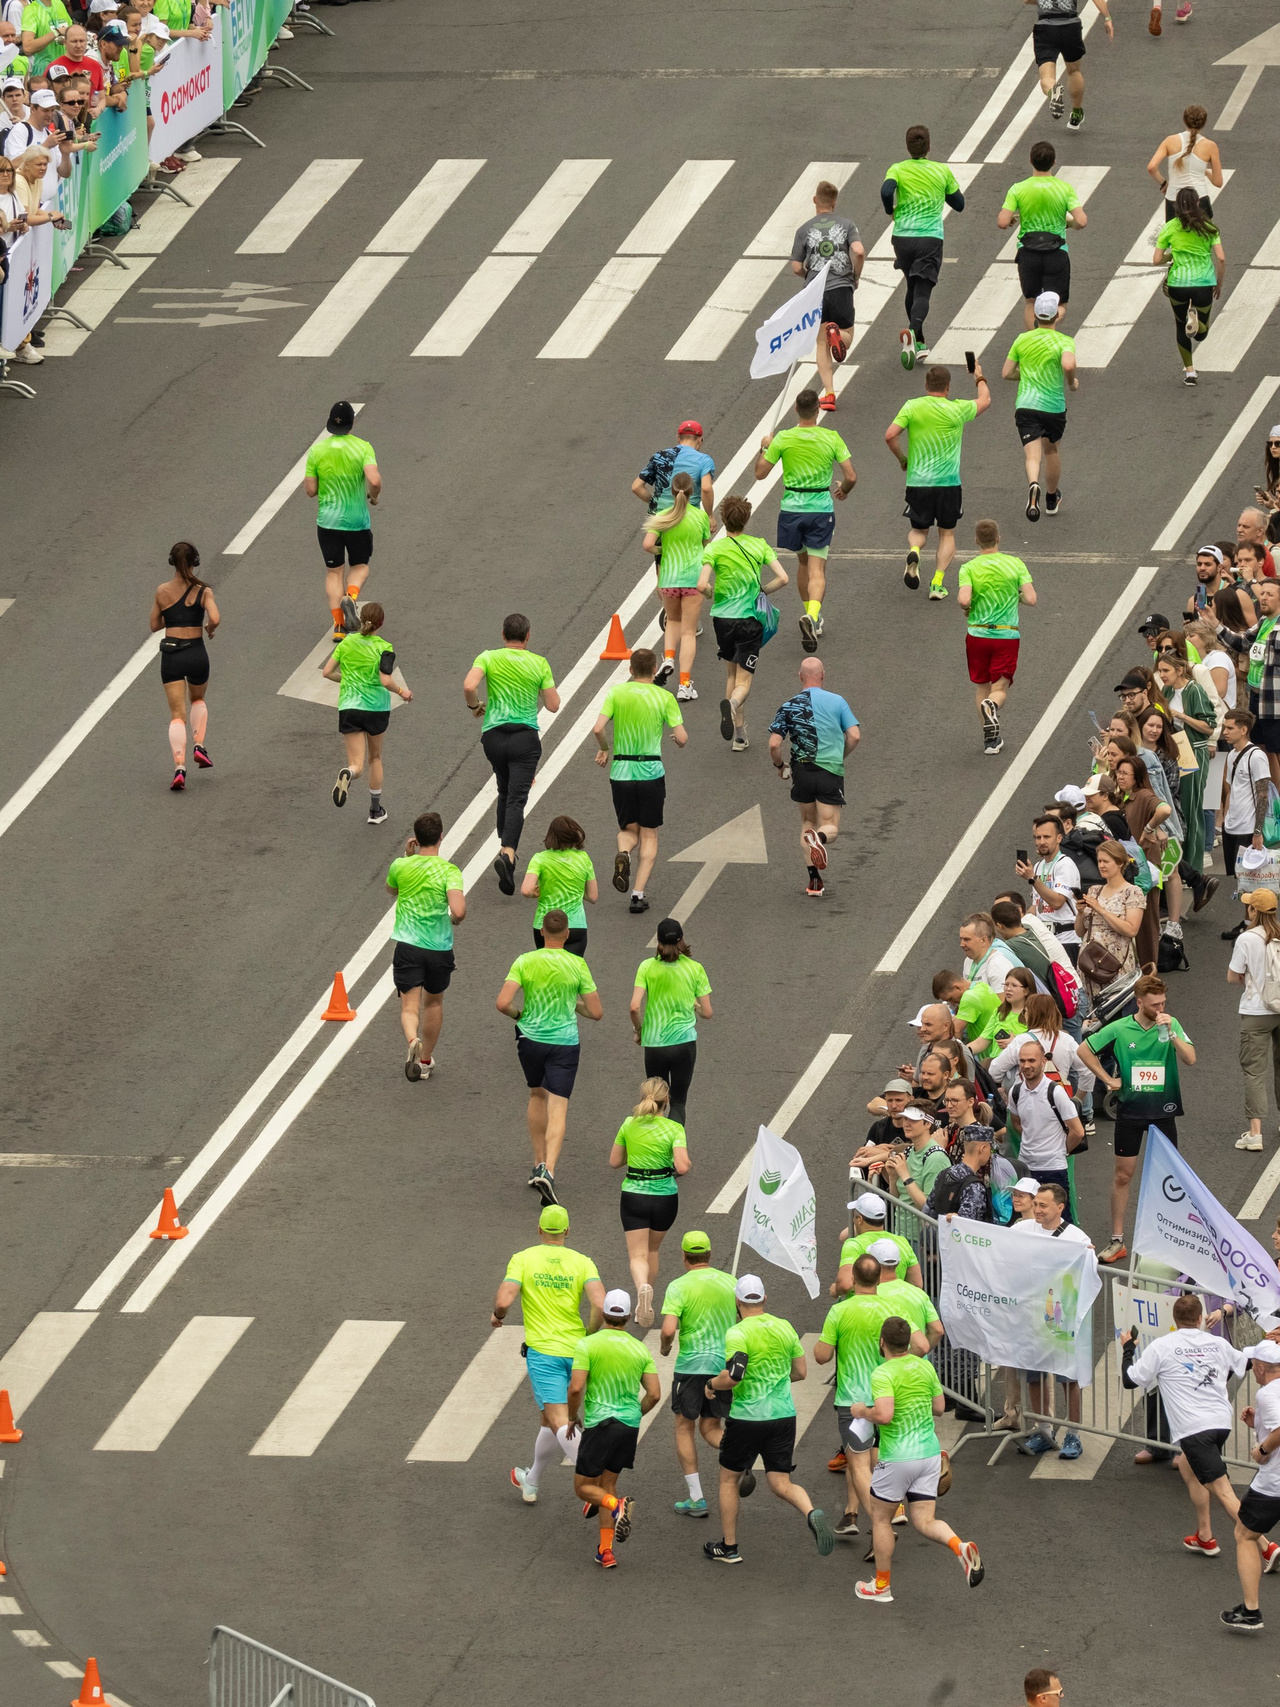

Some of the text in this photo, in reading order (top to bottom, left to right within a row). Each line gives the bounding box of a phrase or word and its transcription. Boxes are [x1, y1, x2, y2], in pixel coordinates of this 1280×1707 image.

[1139, 1071, 1158, 1081] 996
[965, 1234, 992, 1248] СБЕР
[1164, 1231, 1195, 1250] старта
[1197, 1246, 1210, 1257] до
[1220, 1238, 1270, 1288] DOCS
[534, 1273, 574, 1283] СОЗДАВАЯ
[956, 1283, 1018, 1306] Сберегаем
[956, 1300, 991, 1317] вместе
[1133, 1299, 1158, 1327] ТЫ
